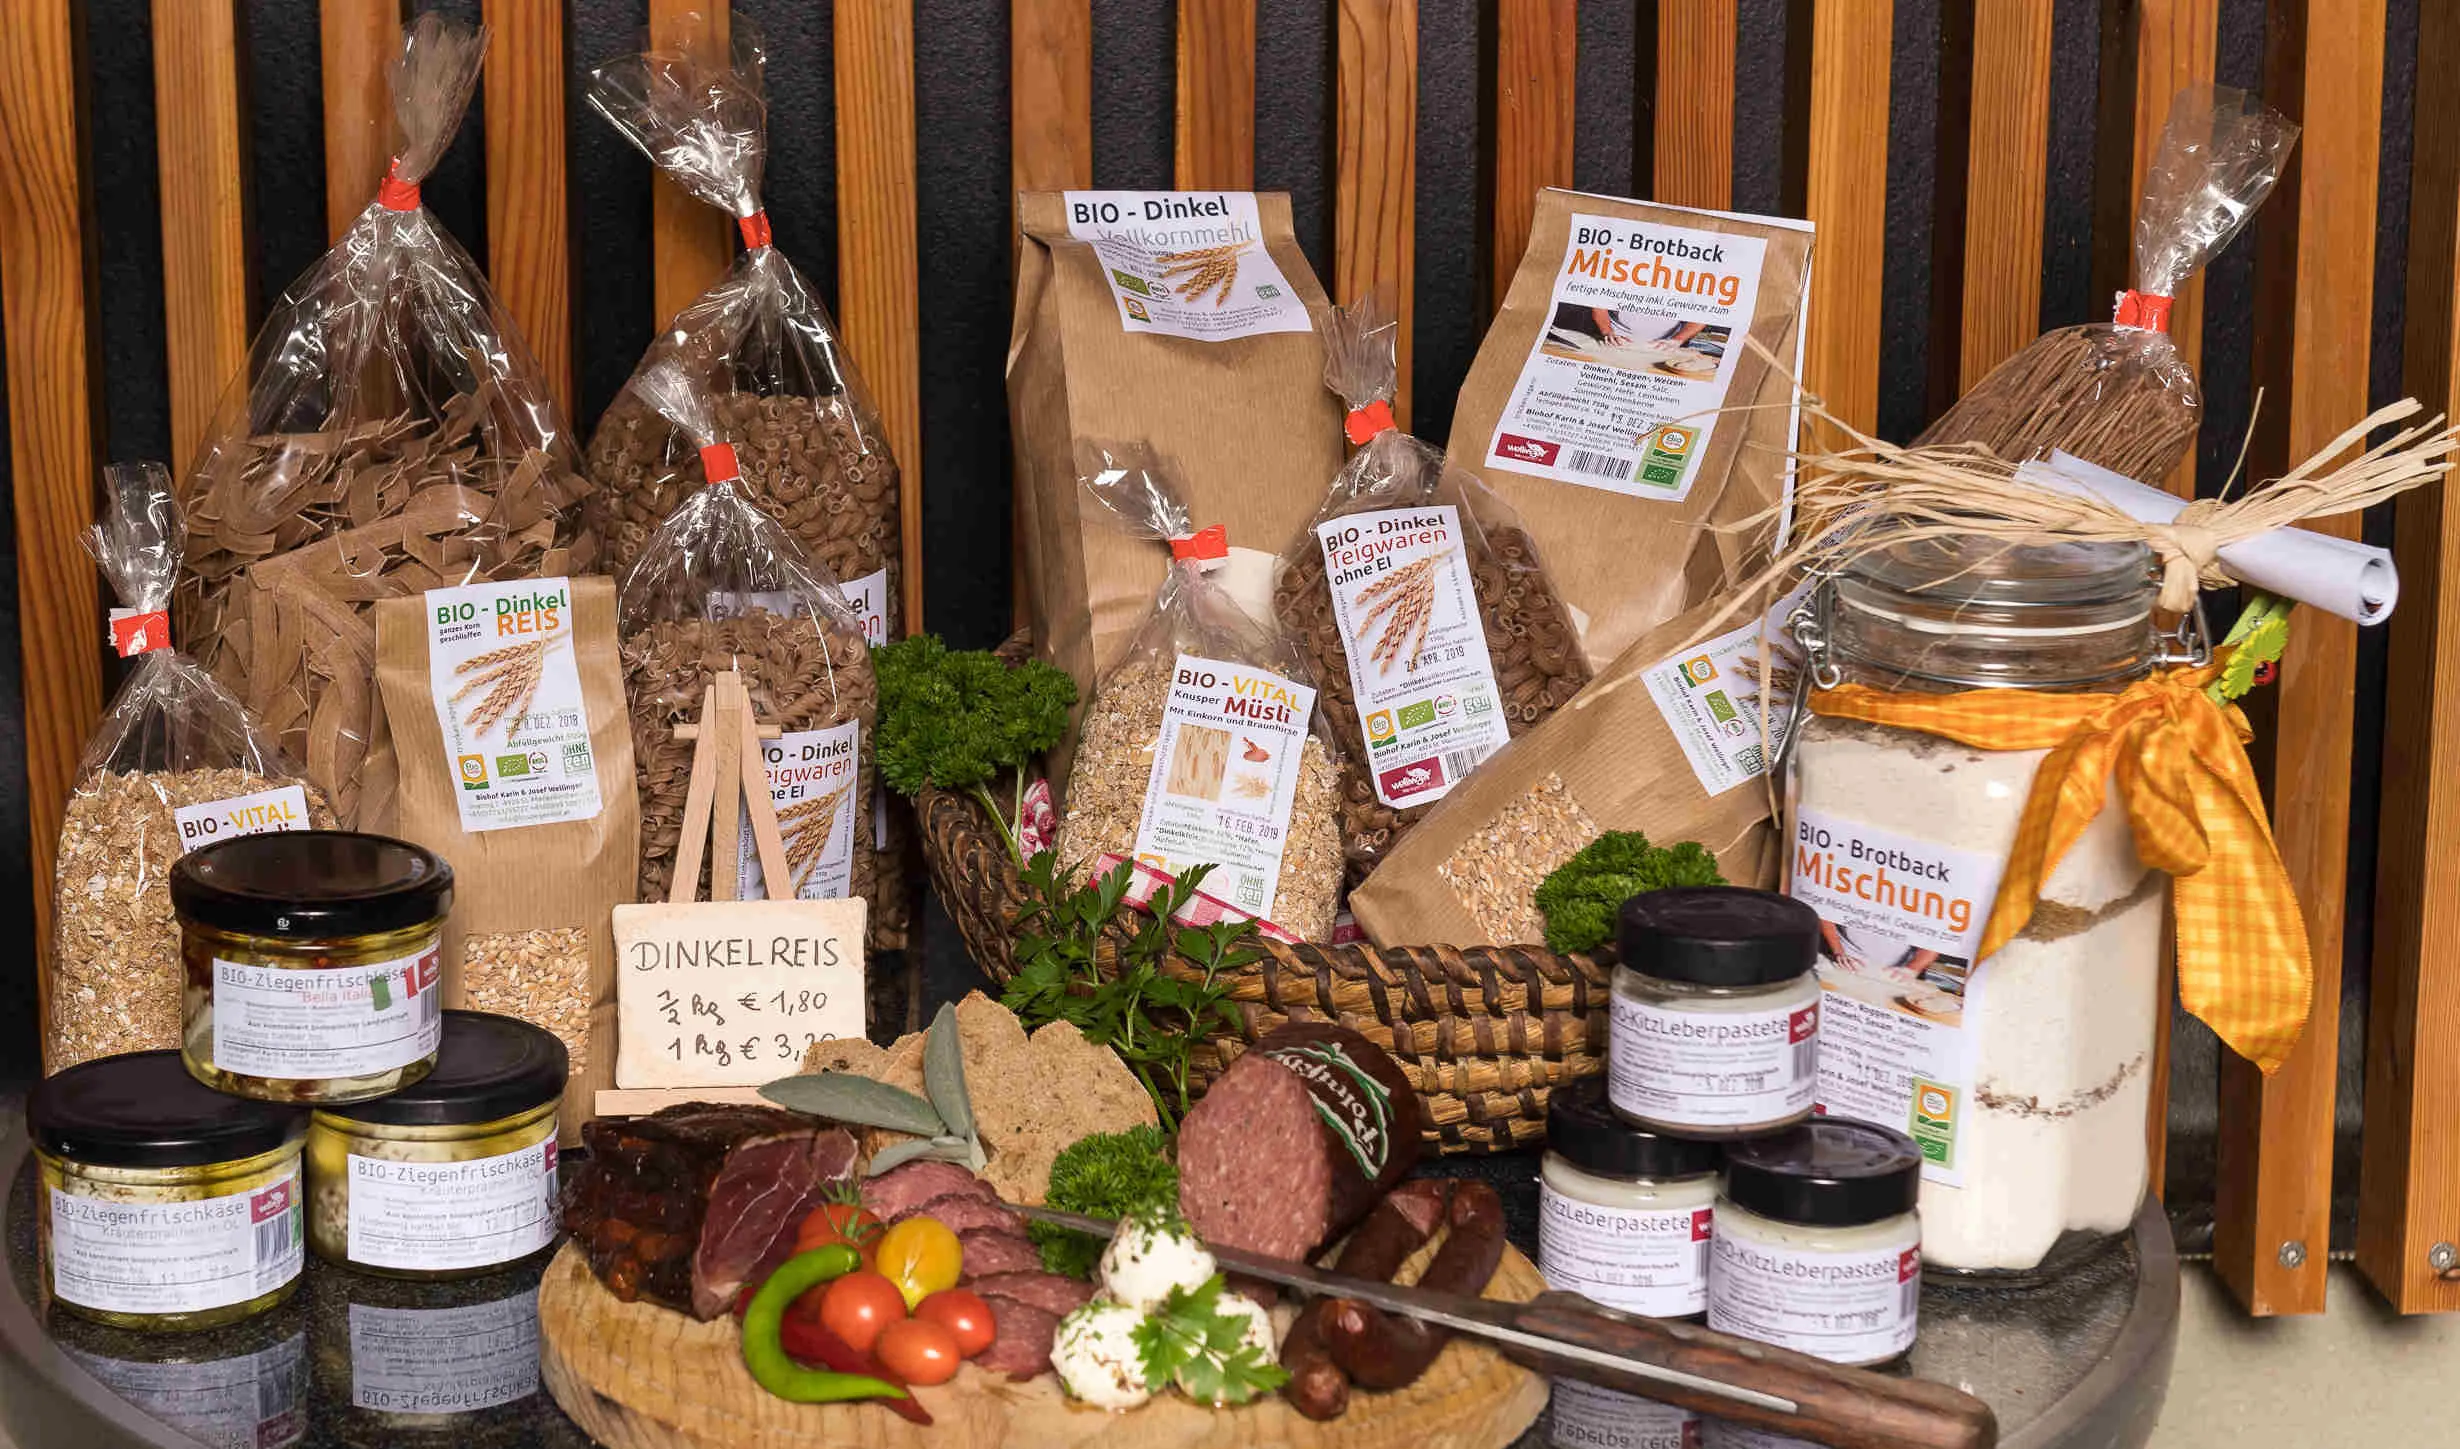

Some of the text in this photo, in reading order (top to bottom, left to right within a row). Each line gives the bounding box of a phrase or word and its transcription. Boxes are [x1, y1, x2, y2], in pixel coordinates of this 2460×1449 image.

[1074, 203, 1119, 224] BIO
[1144, 196, 1229, 221] Dinkel
[1097, 222, 1249, 246] Vollkornmehl
[1577, 228, 1611, 246] BIO
[1630, 234, 1724, 263] Brotback
[1568, 249, 1741, 305] Mischung
[1600, 287, 1644, 304] Mischung
[1709, 307, 1729, 315] zum
[1616, 303, 1678, 319] Selberbacken
[1526, 408, 1554, 419] Biohof
[1555, 412, 1578, 424] Karin
[1587, 419, 1610, 432] Josef
[1325, 528, 1359, 552] BIO
[1379, 514, 1445, 535] Dinkel
[1329, 529, 1447, 569] Teigwaren
[1335, 556, 1392, 585] ohne EI
[437, 602, 475, 625] BIO
[496, 589, 566, 615] Dinkel
[497, 608, 560, 637] REIS
[440, 622, 481, 636] ganzes Korn
[440, 630, 482, 644] geschliffen
[1174, 688, 1291, 723] Knusper Müsli
[1178, 669, 1216, 688] BIO
[1233, 675, 1302, 713] VITAL
[1169, 705, 1185, 716] Mit
[1188, 710, 1223, 722] Einkorn
[1227, 718, 1244, 726] und
[802, 735, 853, 761] Dinkel
[1374, 745, 1399, 759] Biohof
[1400, 738, 1421, 751] Karin
[1430, 728, 1450, 742] Josef
[766, 757, 851, 788] eigwaren
[791, 785, 804, 798] EI
[183, 817, 218, 838] BIO
[229, 800, 297, 829] VITAL
[1259, 824, 1279, 839] 2019
[1800, 821, 1831, 849] BIO
[1851, 839, 1950, 882] Brotback
[1797, 845, 1972, 933] Mischung
[691, 994, 725, 1026] kg
[737, 992, 761, 1011] €
[770, 990, 827, 1016] 1,80
[668, 1038, 681, 1061] 1
[696, 1034, 731, 1066] kg
[740, 1036, 761, 1060] €
